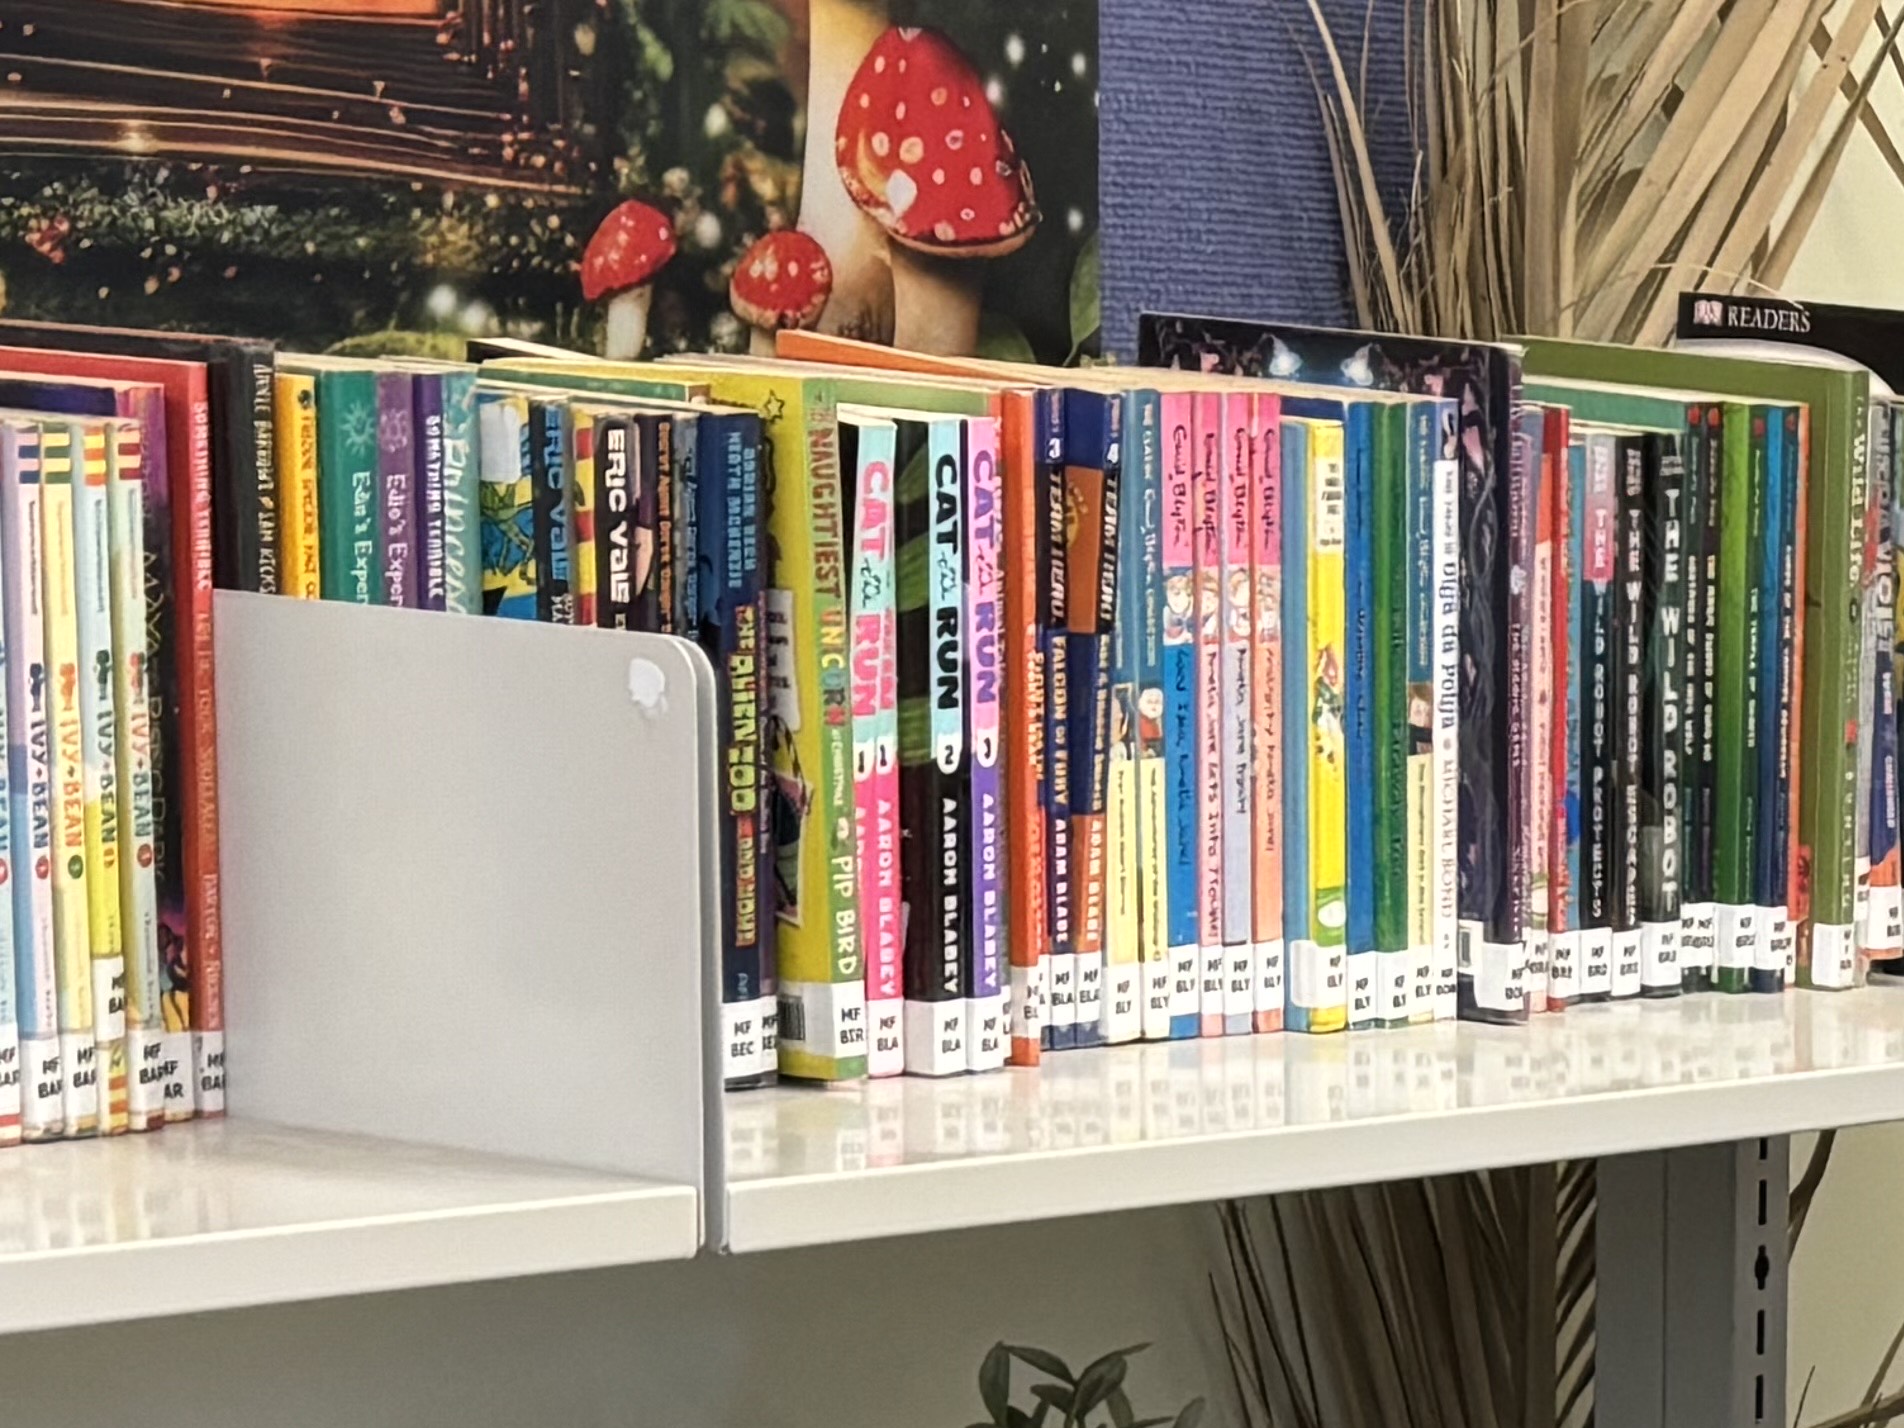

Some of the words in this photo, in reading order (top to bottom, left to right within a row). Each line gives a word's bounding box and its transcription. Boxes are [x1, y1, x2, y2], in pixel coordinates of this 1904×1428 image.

[1726, 304, 1811, 334] READERS
[604, 427, 628, 515] ERIC
[808, 427, 842, 600] NAUGHTIEST
[859, 460, 890, 561] CAT
[933, 453, 959, 555] CAT
[971, 449, 997, 550] CAT
[1627, 508, 1642, 574] THE
[1663, 488, 1681, 584] THE
[851, 613, 881, 718] RUN
[935, 606, 961, 711] RUN
[974, 601, 998, 705] RUN
[1626, 581, 1642, 667] WILD
[1661, 606, 1681, 734] WILD
[29, 718, 47, 766] IVY
[60, 715, 81, 763] IVY
[98, 707, 115, 754] IVY
[944, 744, 955, 766] 2
[1626, 673, 1640, 777] ROBOT
[30, 779, 49, 851] BEAN
[62, 781, 82, 852] BEAN
[98, 773, 115, 844] BEAN
[131, 772, 151, 843] BEAN
[874, 797, 895, 888] AARON
[942, 797, 958, 887] AARON
[980, 792, 996, 881] AARON
[1054, 819, 1068, 876] ADAM
[1661, 754, 1680, 912] ROBOT
[830, 854, 855, 898] PIP
[1055, 882, 1069, 943] BLADE
[833, 908, 857, 977] BIRD
[877, 896, 898, 998] BLABEY
[943, 894, 960, 994] BLABEY
[982, 889, 998, 991] BLABEY
